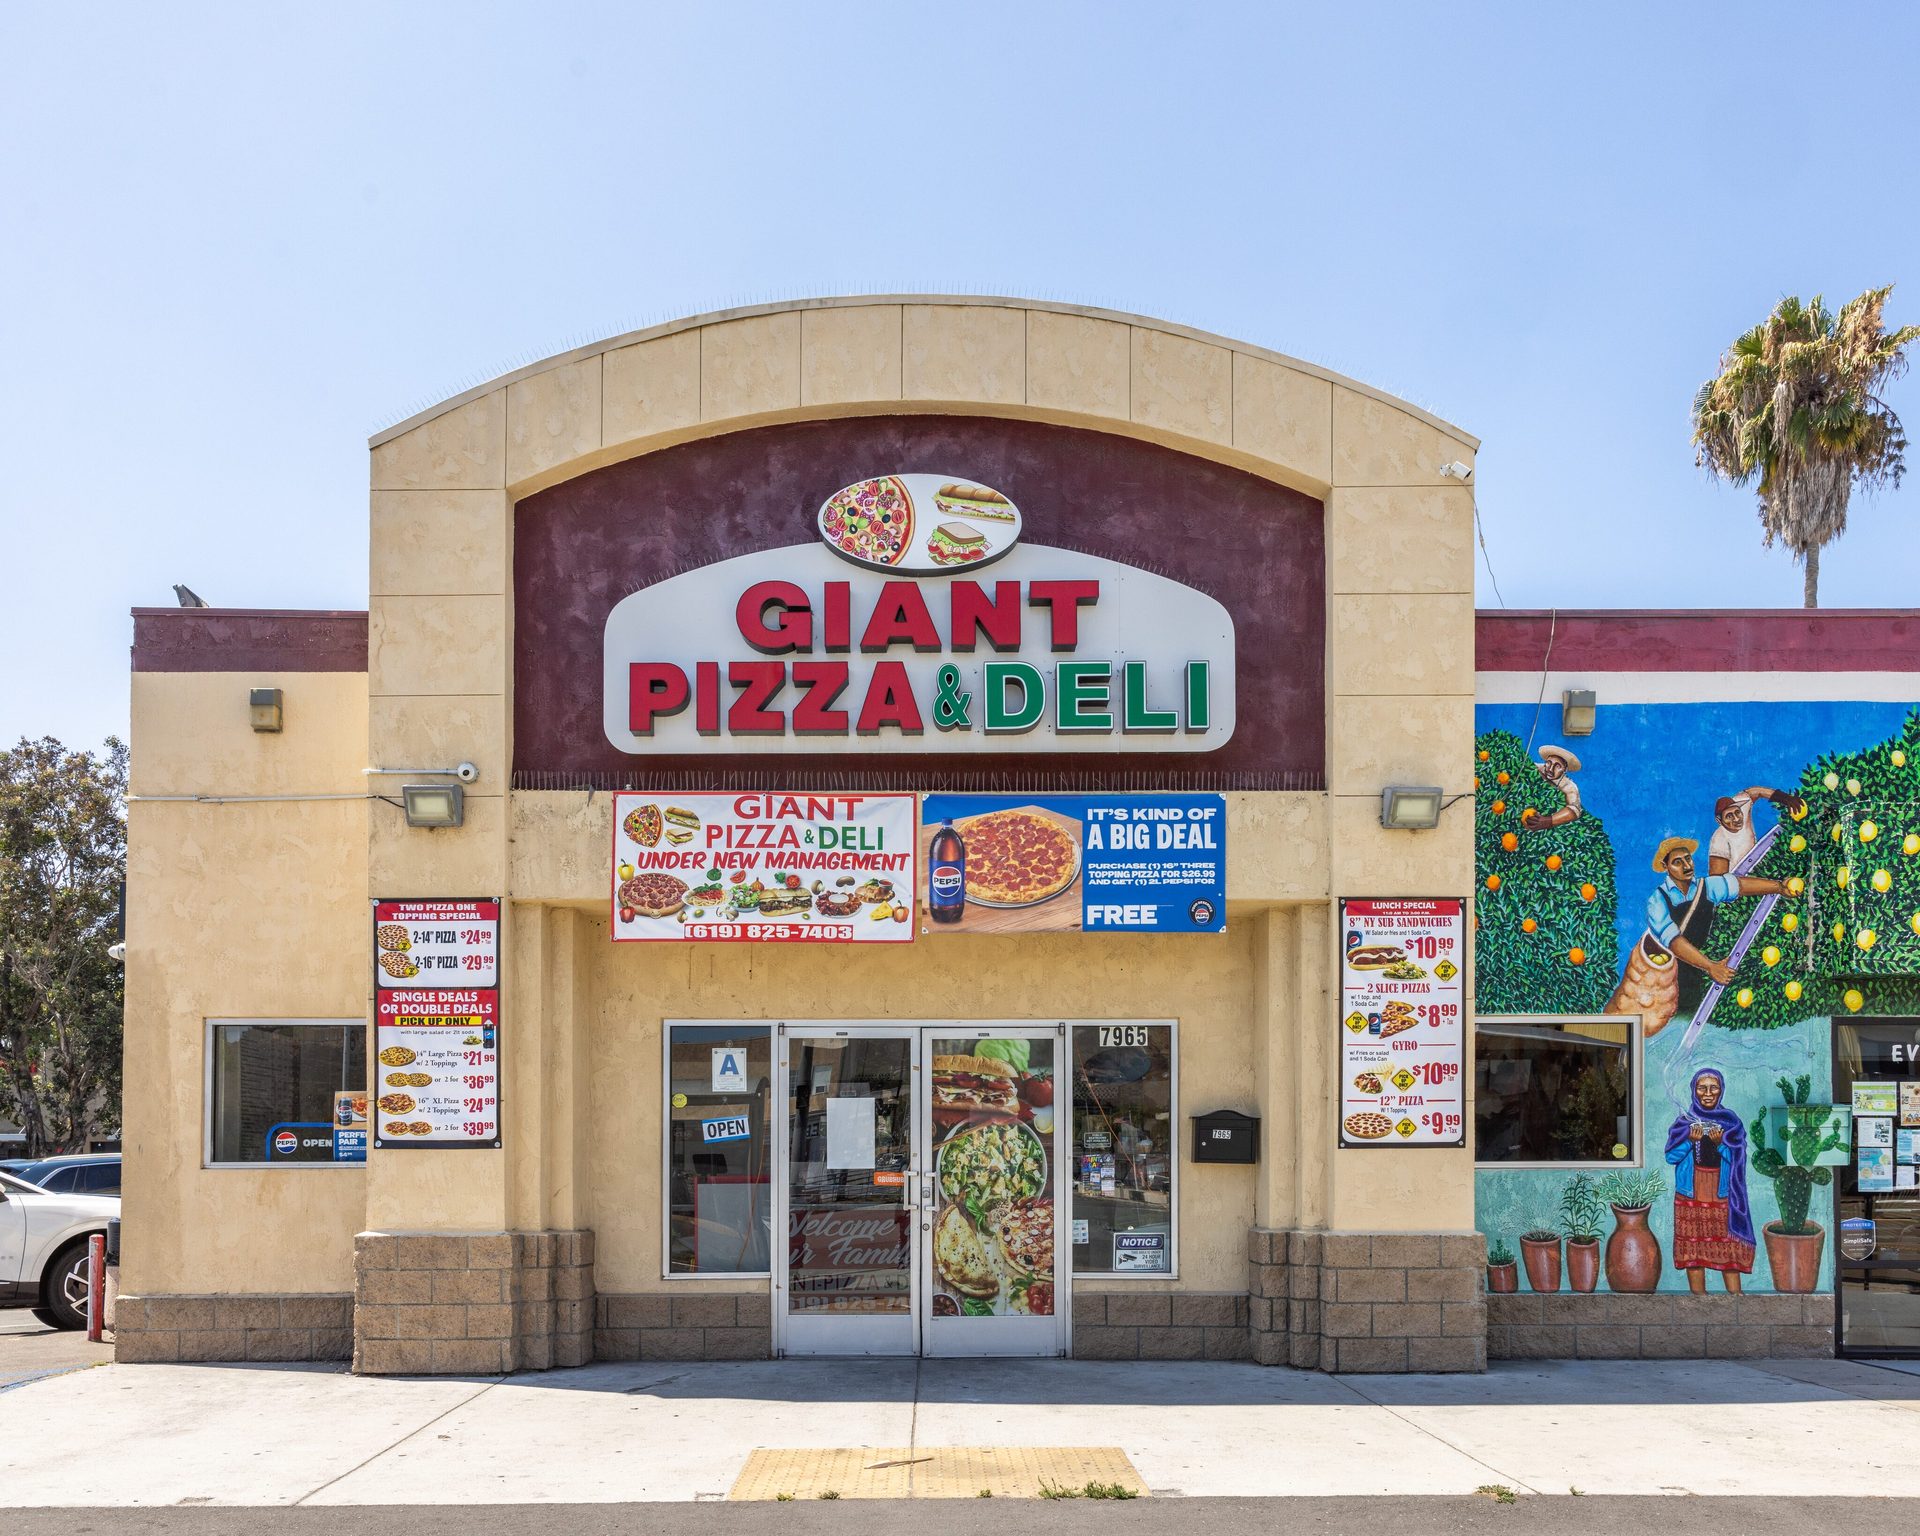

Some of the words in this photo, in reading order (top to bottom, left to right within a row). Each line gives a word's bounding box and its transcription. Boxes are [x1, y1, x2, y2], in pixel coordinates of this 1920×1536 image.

[736, 579, 1100, 655] GIANT
[628, 661, 925, 737] PIZZA
[932, 662, 973, 730] &
[983, 659, 1211, 735] DELI
[733, 795, 864, 821] GIANT
[1087, 807, 1129, 821] IT'S
[1132, 807, 1184, 821] KIND
[1193, 808, 1217, 821] OF
[706, 824, 801, 849] PIZZA
[804, 829, 815, 844] &
[818, 826, 884, 851] DELI
[1087, 823, 1104, 850] A
[1110, 823, 1151, 850] BIG
[1156, 823, 1217, 850] DEAL
[637, 851, 706, 870] UNDER
[713, 851, 760, 870] NEW
[765, 852, 911, 871] MANAGEMENT
[1148, 862, 1160, 871] (1)
[934, 877, 960, 885] PEPSI
[1088, 870, 1130, 879] TOPPING
[1132, 870, 1160, 879] PIZZA
[1161, 870, 1181, 879] FOR
[1181, 870, 1216, 879] $26.99
[1135, 878, 1148, 886] (1)
[1087, 904, 1158, 925] FREE
[1364, 917, 1375, 927] NY
[1378, 917, 1394, 927] SUB
[1397, 917, 1452, 927] SANDWICHES
[413, 930, 434, 944] 2-14"
[435, 931, 456, 944] PIZZA
[685, 924, 742, 939] (619)
[747, 925, 853, 940] 825-7403
[415, 956, 435, 969] 2-16"
[437, 956, 458, 969] PIZZA
[1367, 983, 1373, 993] 2
[1376, 983, 1399, 993] SLICE
[1402, 983, 1430, 993] PIZZAS
[392, 992, 436, 1002] SINGLE
[438, 992, 478, 1002] DEALS
[380, 1004, 398, 1014] OR
[401, 1004, 451, 1014] DOUBLE
[453, 1003, 492, 1014] DEALS
[400, 1017, 426, 1025] PICK
[428, 1017, 443, 1025] UP
[445, 1017, 471, 1025] ONLY
[1101, 1026, 1147, 1046] 7965
[1392, 1041, 1417, 1050] GYRO
[428, 1050, 445, 1058] Large
[1892, 1044, 1920, 1062] EV
[720, 1054, 740, 1075] A
[1398, 1096, 1424, 1105] PIZZA
[707, 1119, 746, 1138] OPEN
[1213, 1130, 1231, 1139] 7965
[1122, 1238, 1158, 1246] NOTICE
